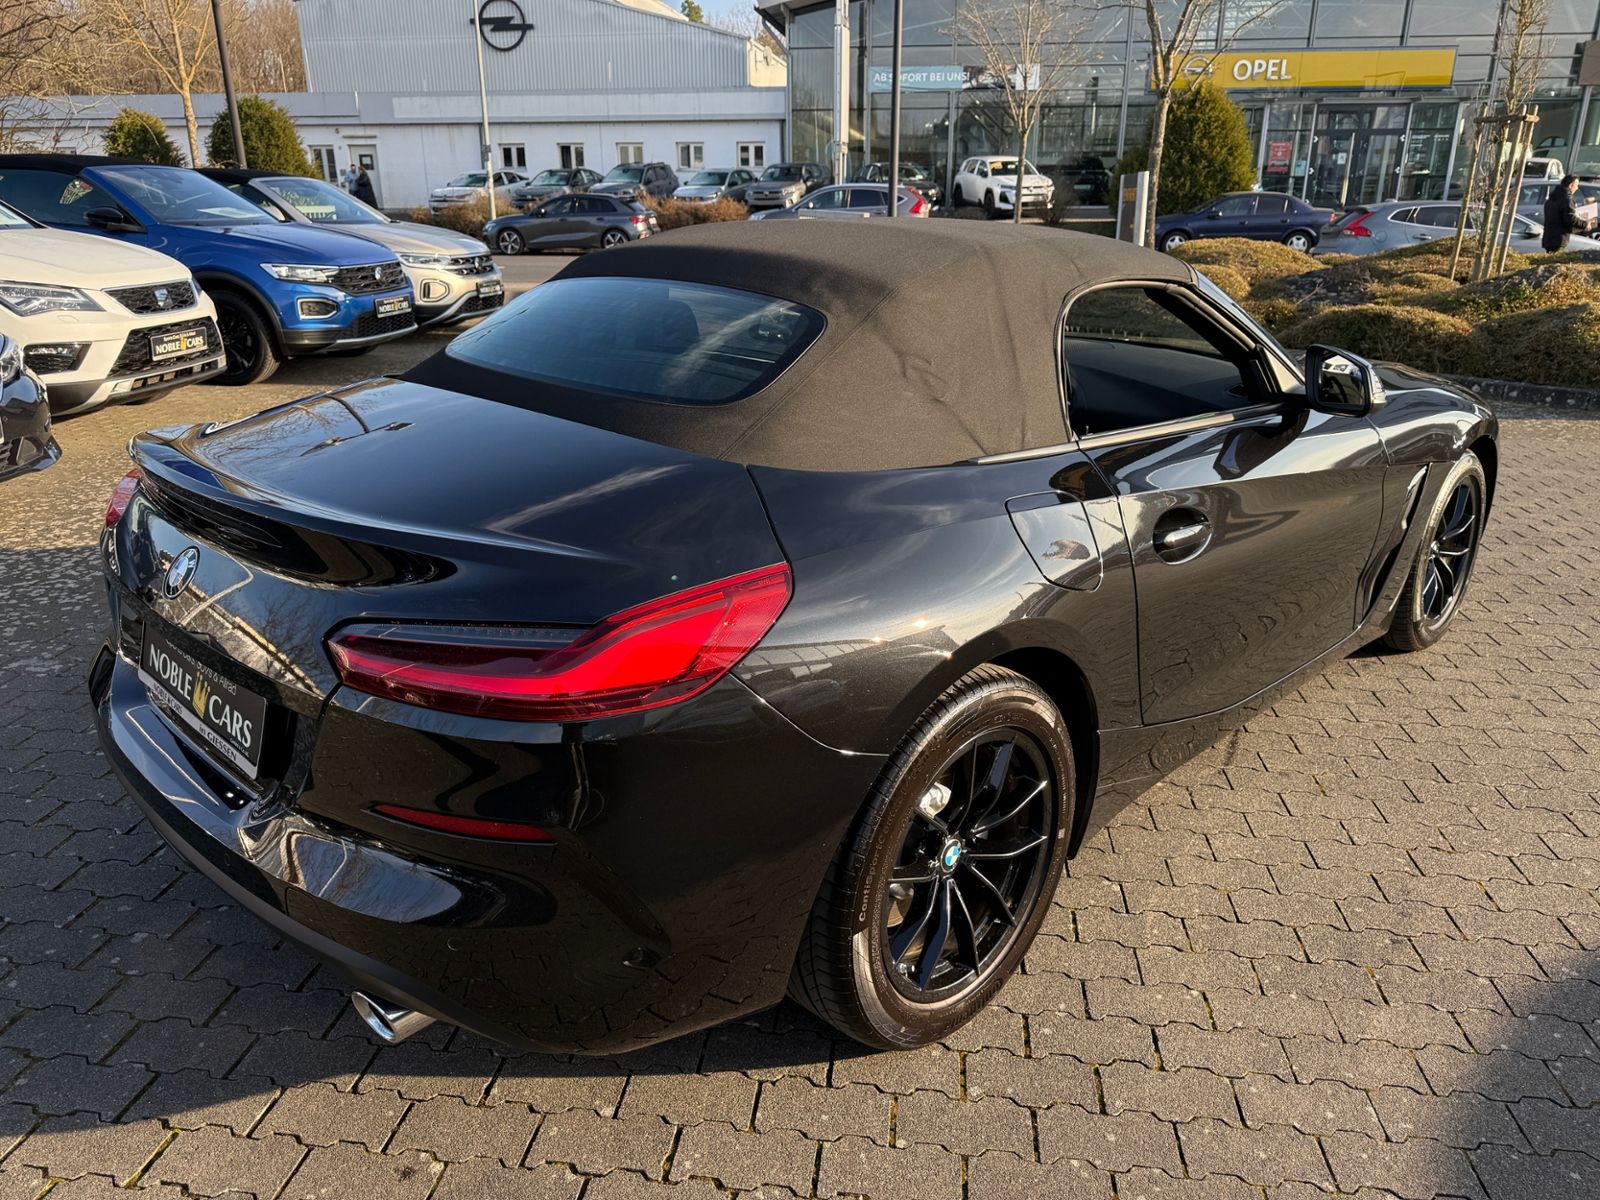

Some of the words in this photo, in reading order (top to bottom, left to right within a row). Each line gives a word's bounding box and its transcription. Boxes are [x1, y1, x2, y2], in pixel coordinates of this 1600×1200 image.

[873, 72, 887, 82] AB
[929, 72, 945, 81] BEI
[946, 71, 970, 81] UNS!
[1232, 58, 1292, 81] OPEL
[155, 341, 181, 354] NOBLE
[186, 336, 204, 348] CARS
[150, 643, 193, 701] NOBLE
[208, 694, 252, 748] CARS
[206, 730, 237, 761] GIESSEN
